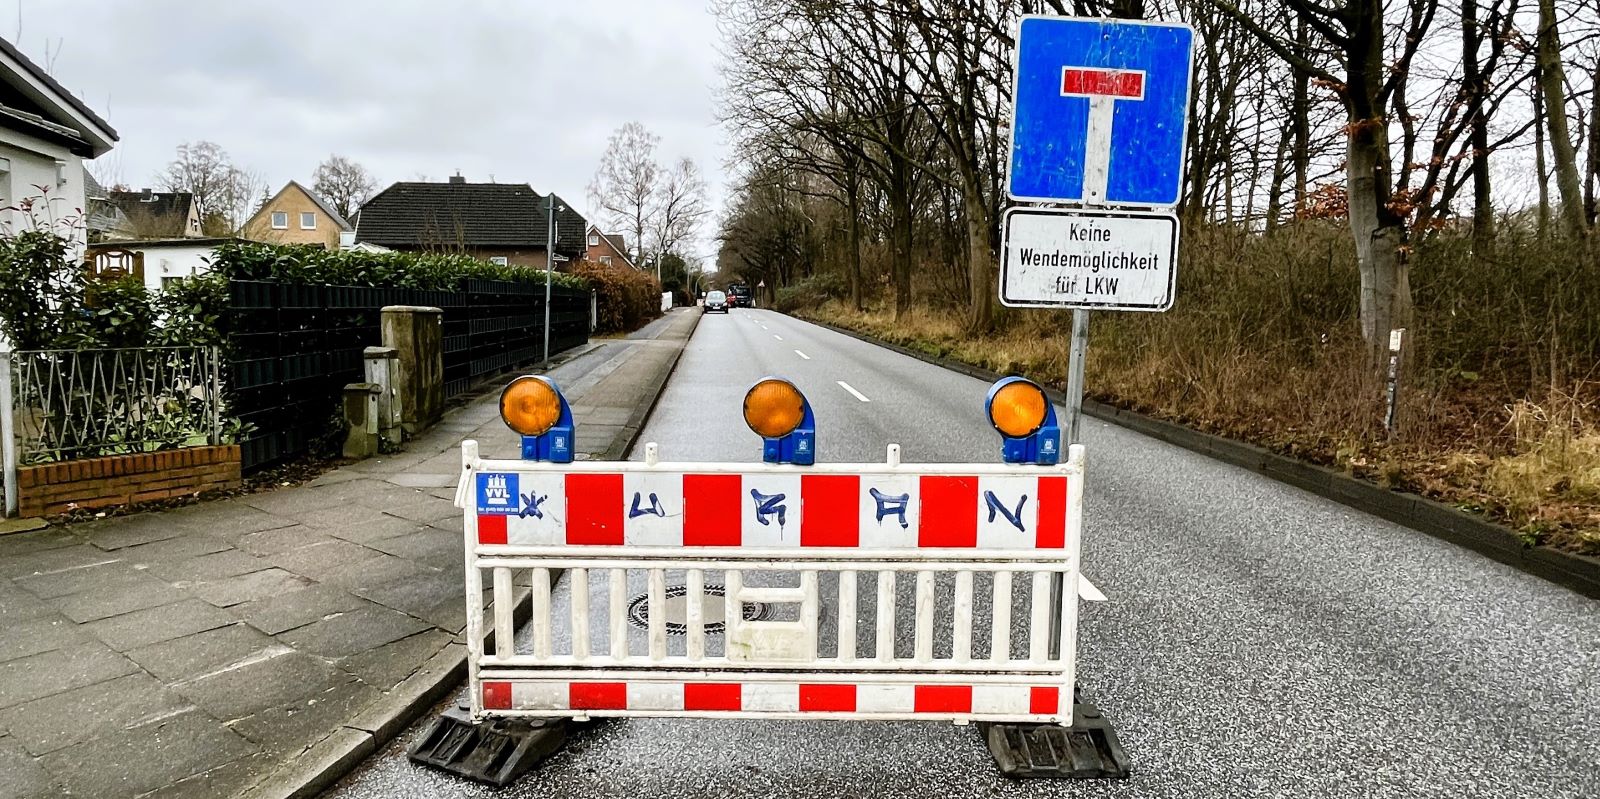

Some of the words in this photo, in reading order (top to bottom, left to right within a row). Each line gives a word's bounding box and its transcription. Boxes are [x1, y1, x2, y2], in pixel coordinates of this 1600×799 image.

[1070, 222, 1111, 242] Keine
[1020, 248, 1159, 273] Wendemöglichkeit
[1055, 276, 1077, 294] für
[1085, 277, 1119, 296] LKW
[485, 487, 511, 499] VVL
